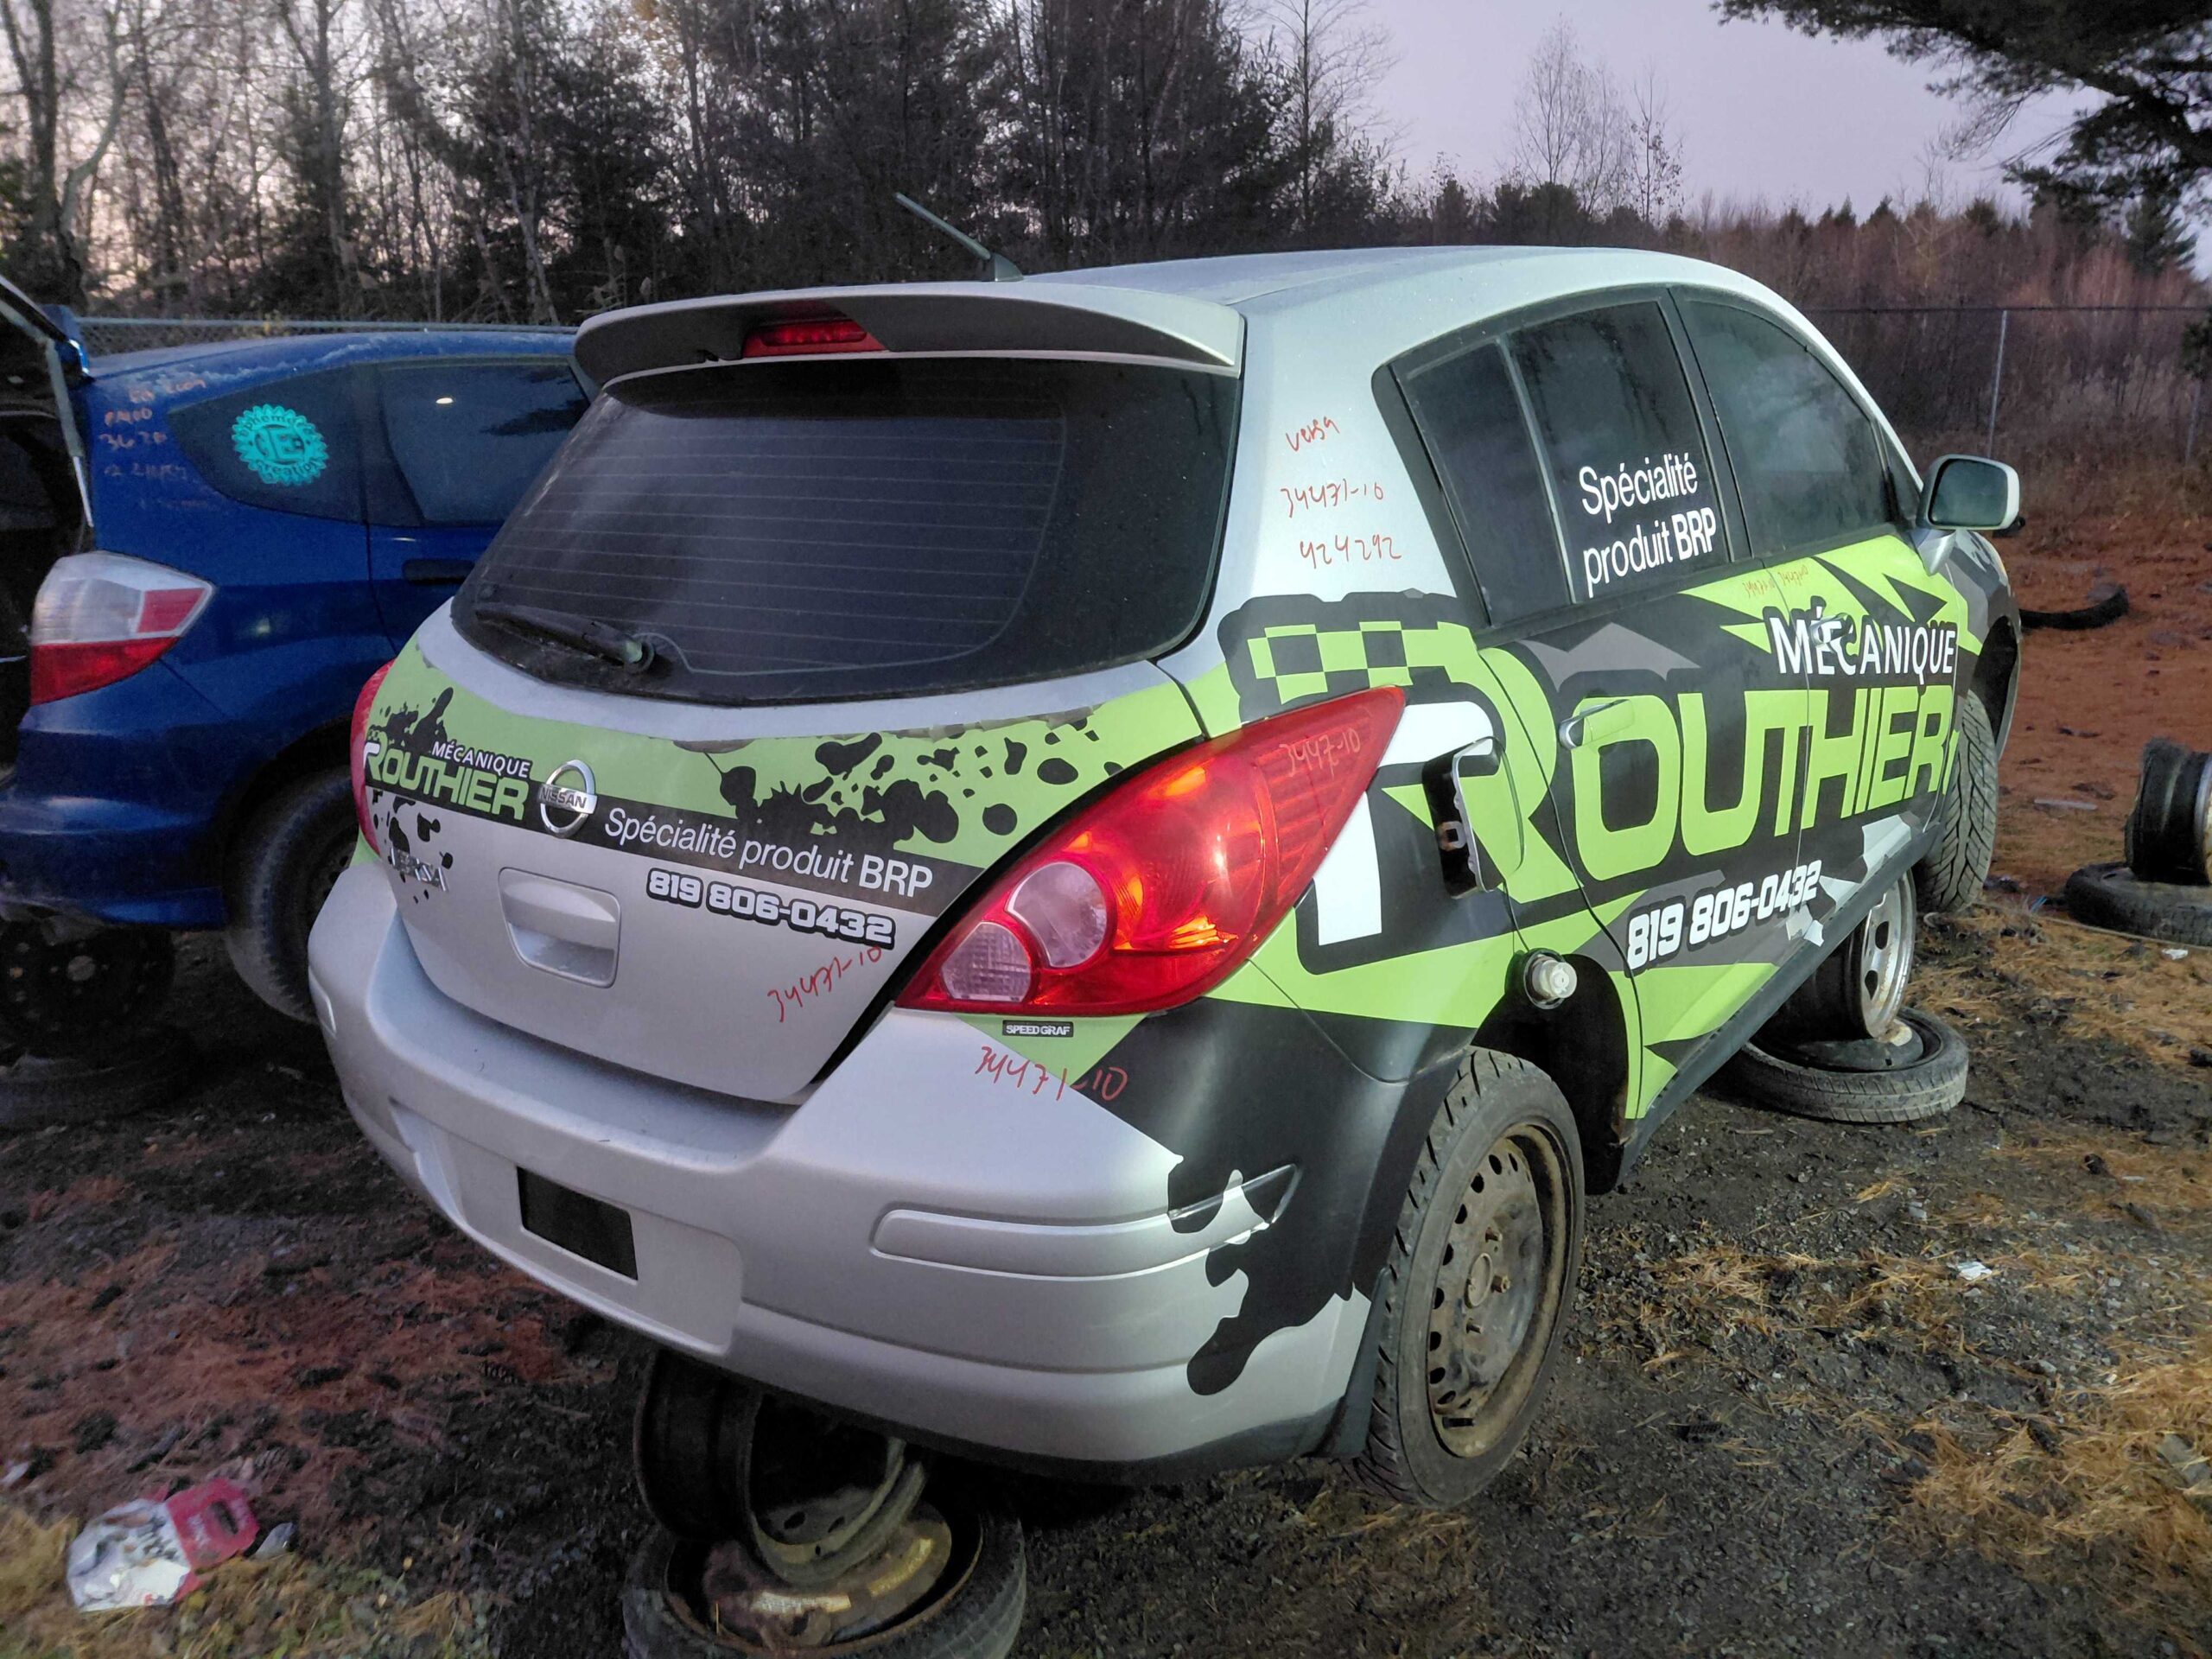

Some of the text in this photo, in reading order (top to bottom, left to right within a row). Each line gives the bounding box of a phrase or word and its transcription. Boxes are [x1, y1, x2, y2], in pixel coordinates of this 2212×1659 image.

[1579, 452, 1699, 524] Spécialité
[1583, 506, 1717, 599] produit BRP
[1769, 606, 1957, 685] MÉCANIQUE
[363, 730, 530, 822] ROUTHIER
[433, 740, 531, 779] MÉCANIQUE
[540, 787, 588, 810] NISSAN
[1315, 621, 1960, 946] ROUTHIER
[605, 807, 933, 898] Spécialité produit BRP
[648, 869, 894, 947] 819 806-0432
[1626, 859, 1822, 971] 819 806-0432
